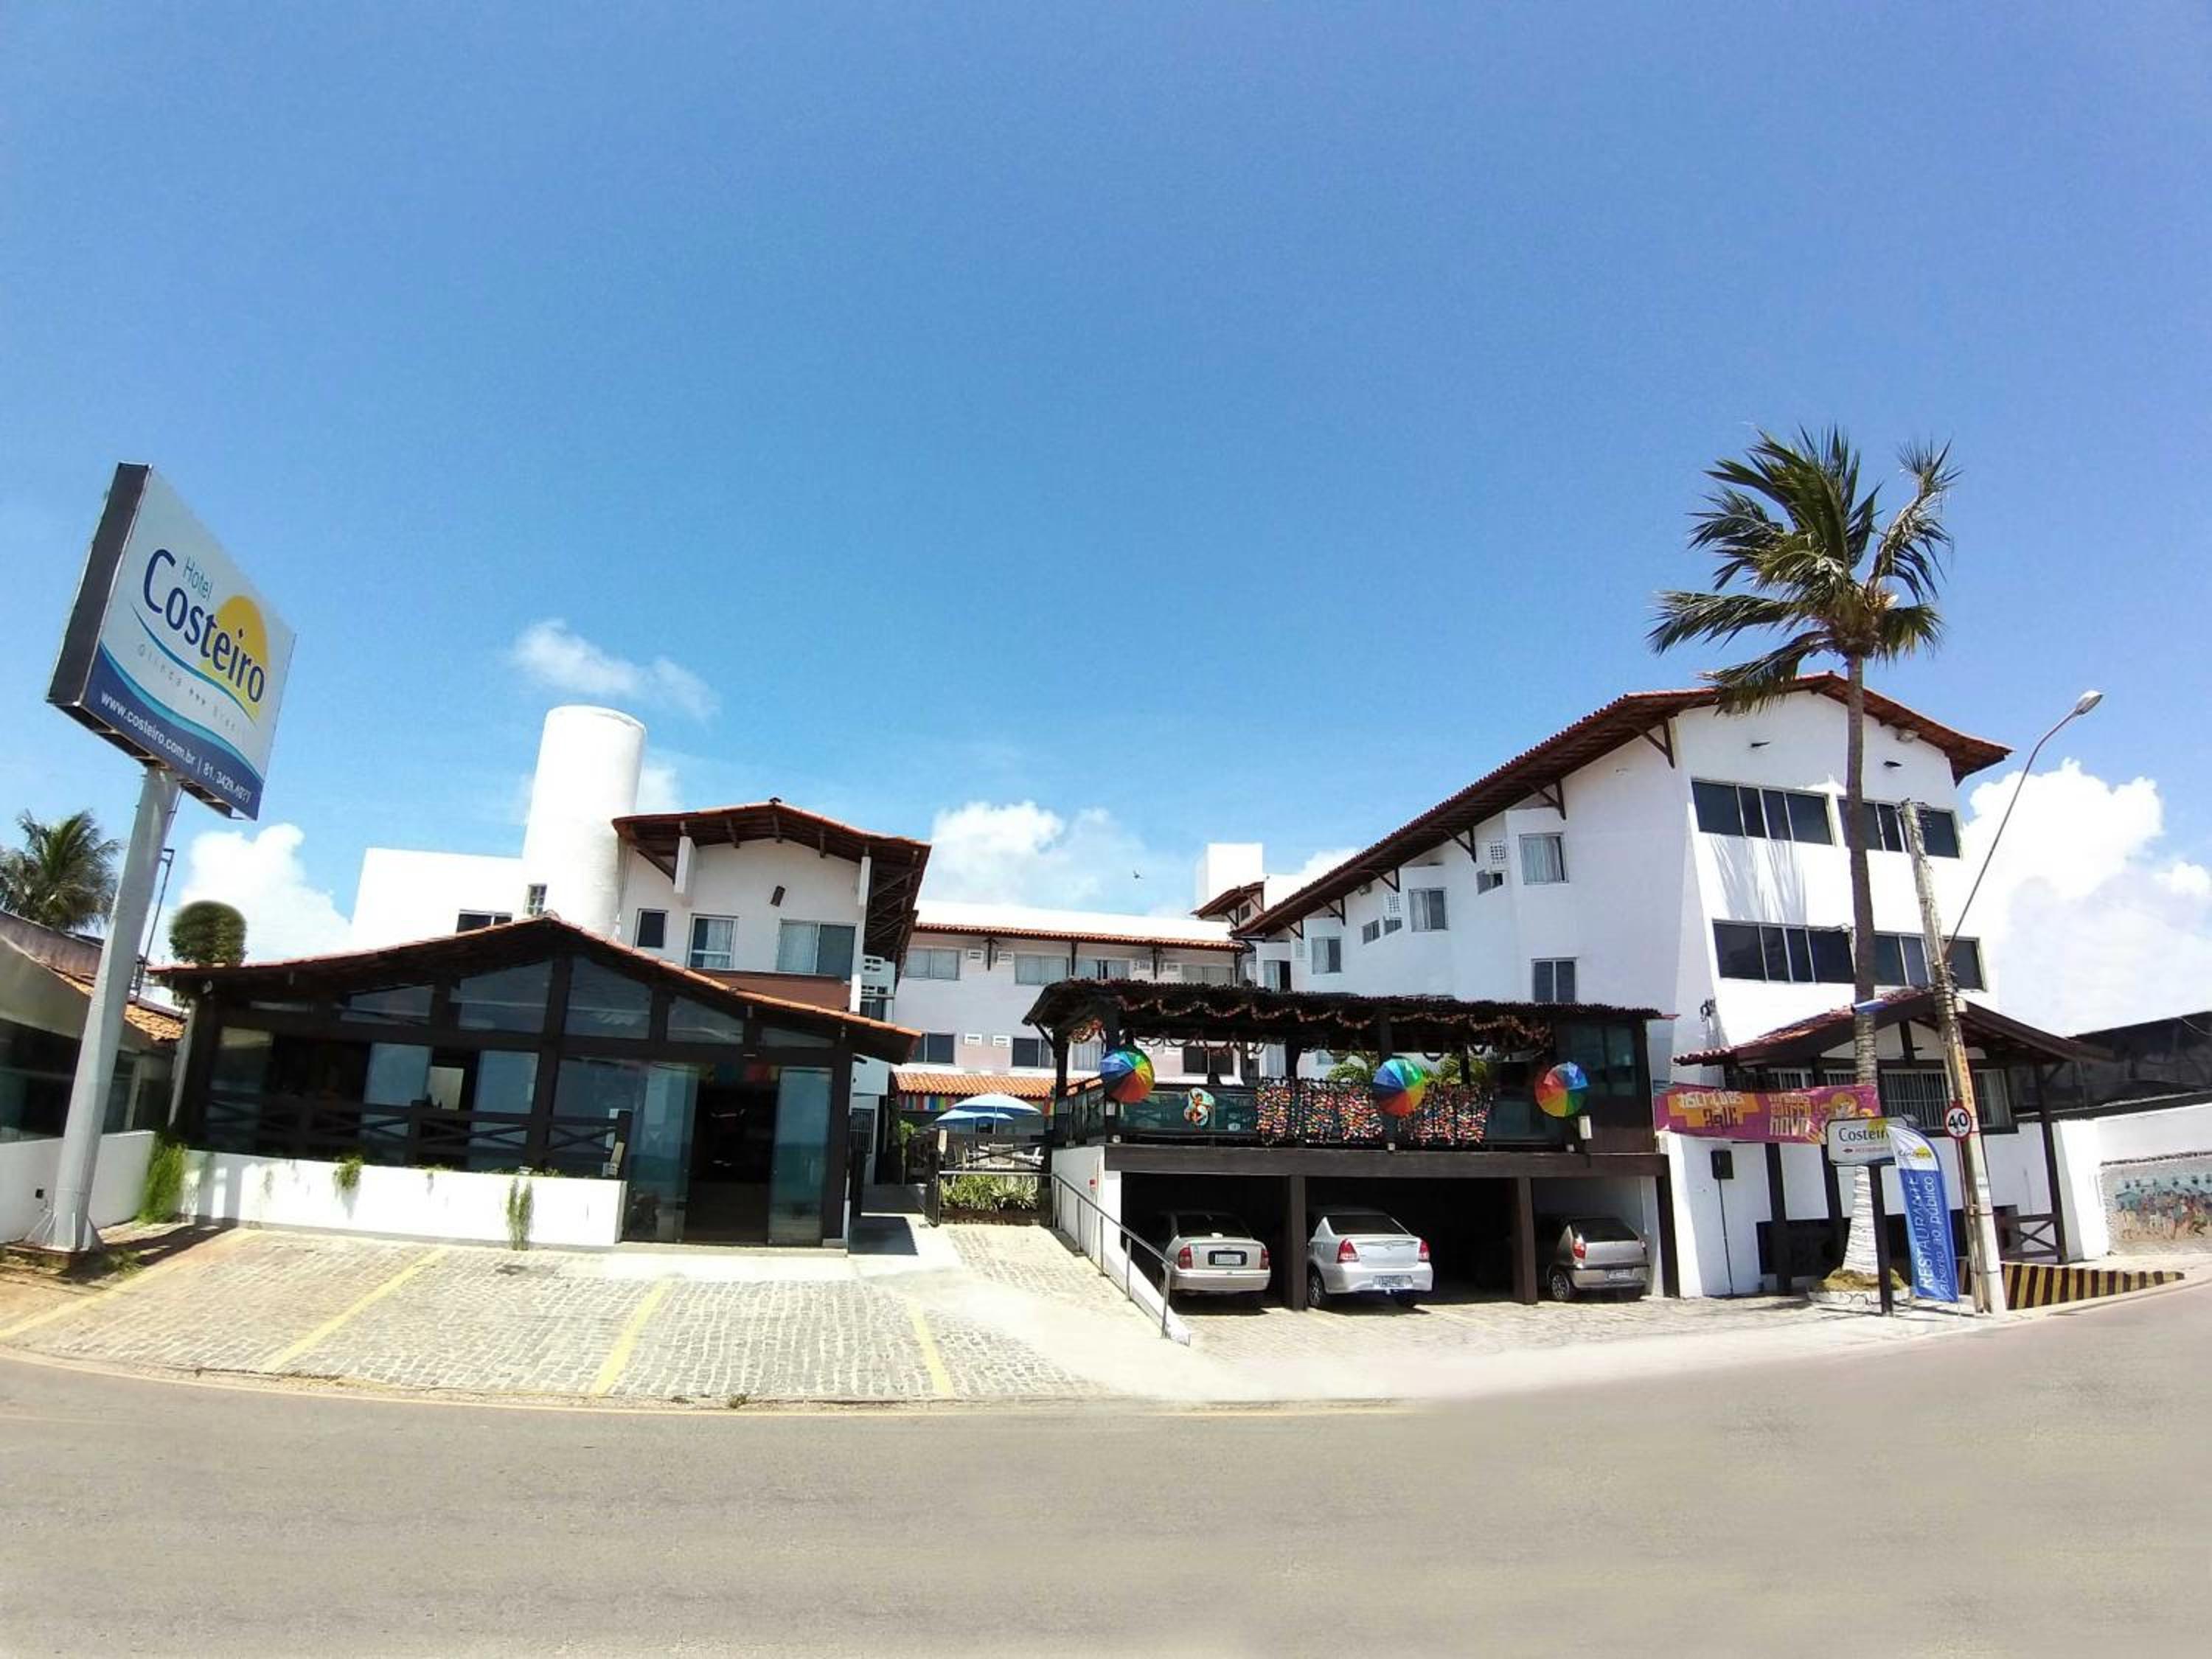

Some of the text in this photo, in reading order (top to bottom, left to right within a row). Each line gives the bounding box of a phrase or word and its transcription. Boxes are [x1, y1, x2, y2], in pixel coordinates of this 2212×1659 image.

[183, 556, 213, 601] Hotel
[143, 549, 265, 703] Costeiro
[101, 691, 195, 765] www.costeiro.com.br
[1948, 1112, 1968, 1128] 40
[1924, 1175, 1944, 1225] público
[1908, 1177, 1934, 1288] RESTAURANTE
